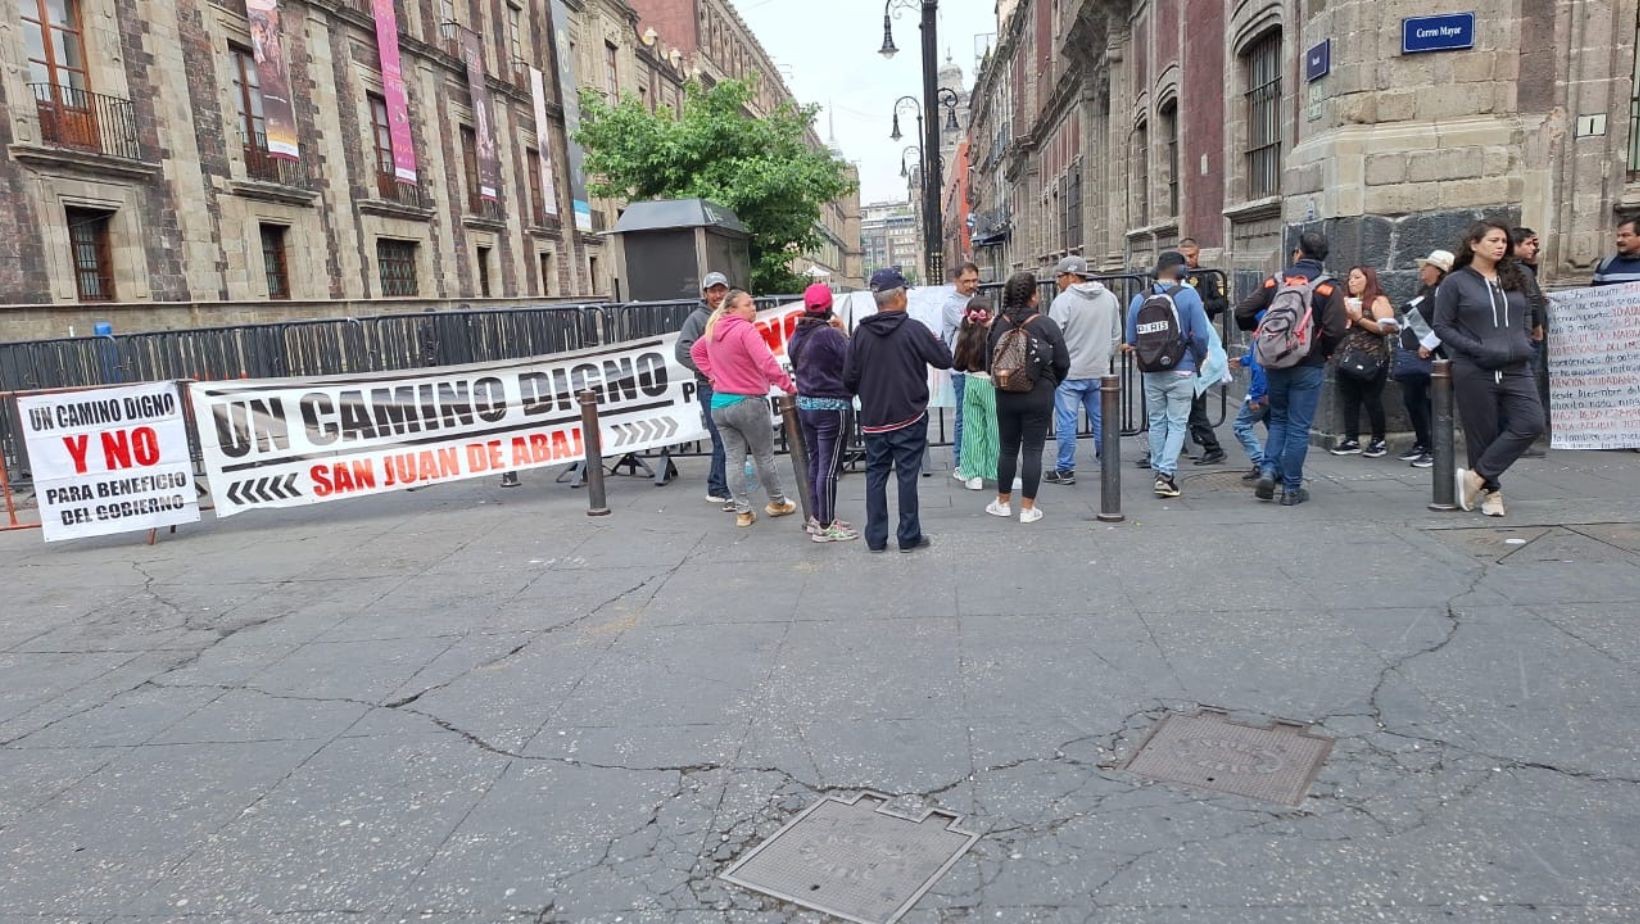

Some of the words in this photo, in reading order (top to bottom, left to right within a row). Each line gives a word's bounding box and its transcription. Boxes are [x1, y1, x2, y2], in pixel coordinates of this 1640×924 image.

[1416, 28, 1438, 38] Correo
[1440, 26, 1462, 36] Mayor
[28, 403, 53, 431] UN
[57, 399, 121, 428] CAMINO
[126, 392, 175, 421] DIGNO
[212, 396, 290, 458] UN
[300, 376, 508, 446] CAMINO
[518, 352, 668, 416] DIGNO
[63, 434, 89, 473] Y
[100, 426, 161, 470] NO
[310, 459, 376, 497] SAN
[384, 447, 460, 486] JUAN
[466, 440, 506, 473] DE
[512, 426, 605, 467] ABAJ
[46, 485, 94, 505] PARA
[98, 471, 187, 498] BENEFICIO
[61, 506, 93, 526] DEL
[98, 494, 185, 520] GOBIERNO
